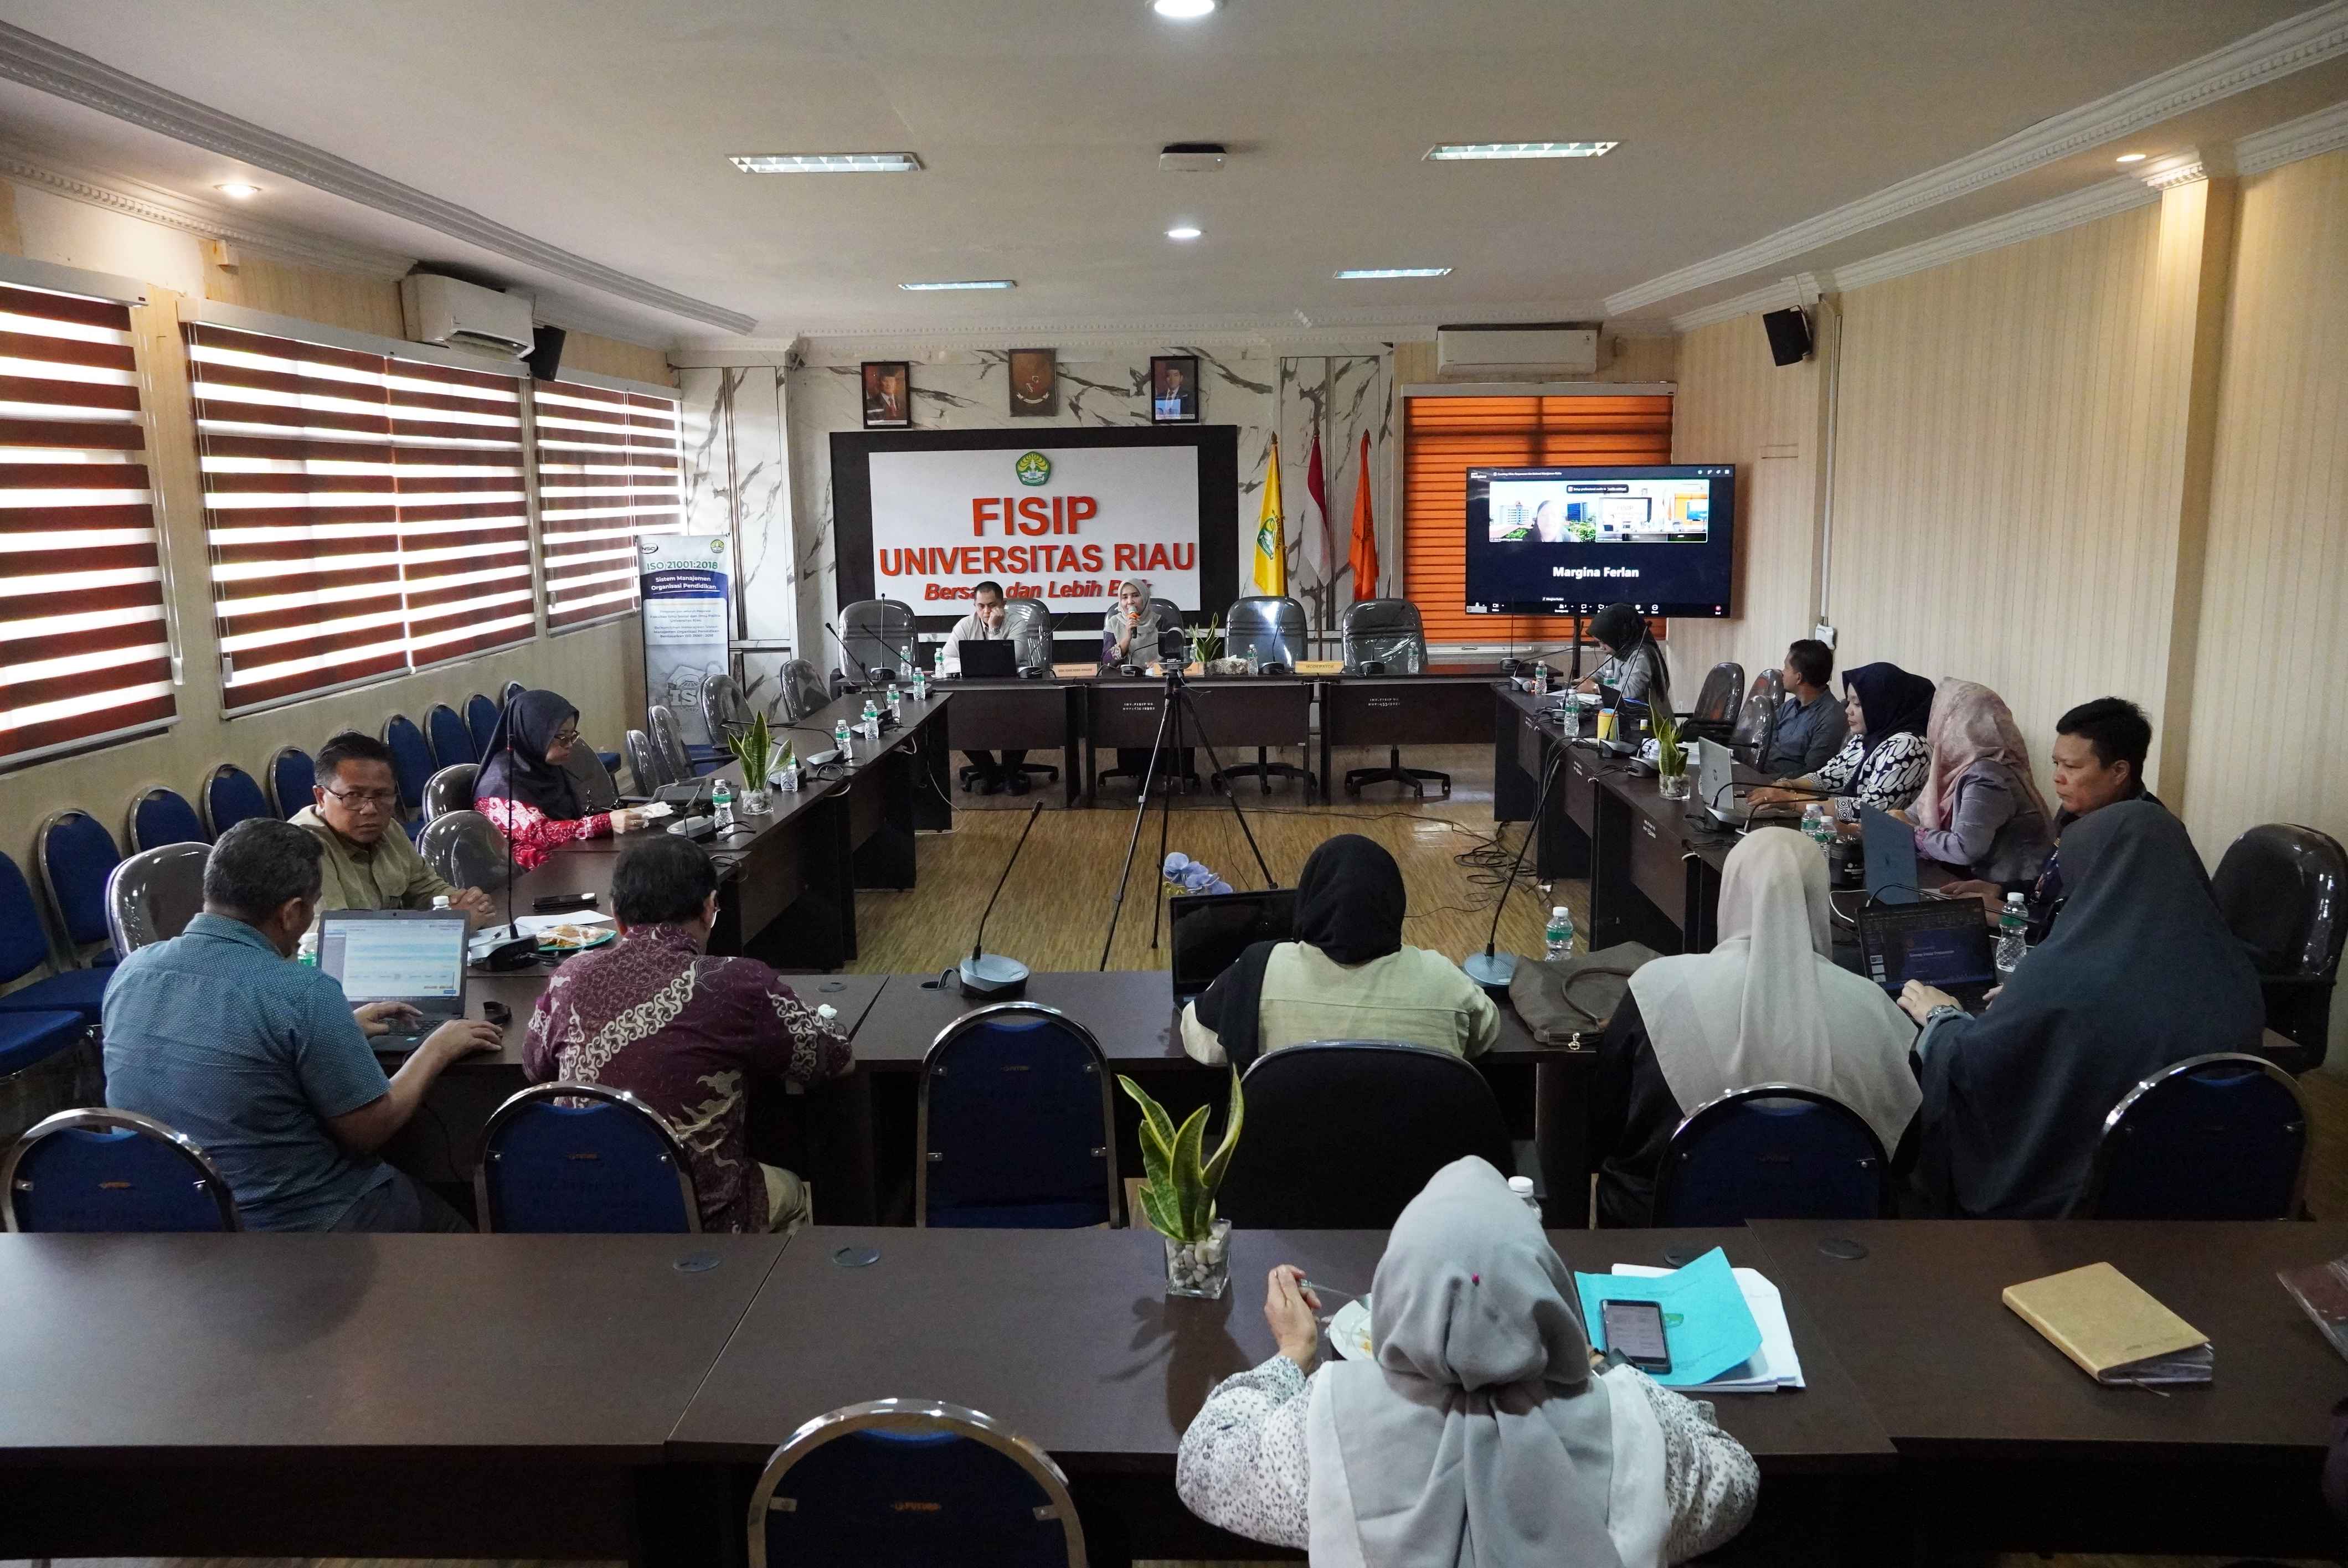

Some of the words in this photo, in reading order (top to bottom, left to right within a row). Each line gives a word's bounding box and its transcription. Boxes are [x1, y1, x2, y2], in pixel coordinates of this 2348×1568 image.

[972, 496, 1098, 537] FISIP
[647, 561, 664, 570] ISO
[667, 560, 718, 569] 21001:2018
[879, 544, 1103, 576] UNIVERSITAS
[1114, 541, 1196, 571] RIAU
[1553, 567, 1600, 579] Margina
[924, 582, 977, 601] Bersa
[1005, 582, 1042, 599] dan
[1048, 580, 1103, 598] Lebih
[669, 689, 701, 706] IS
